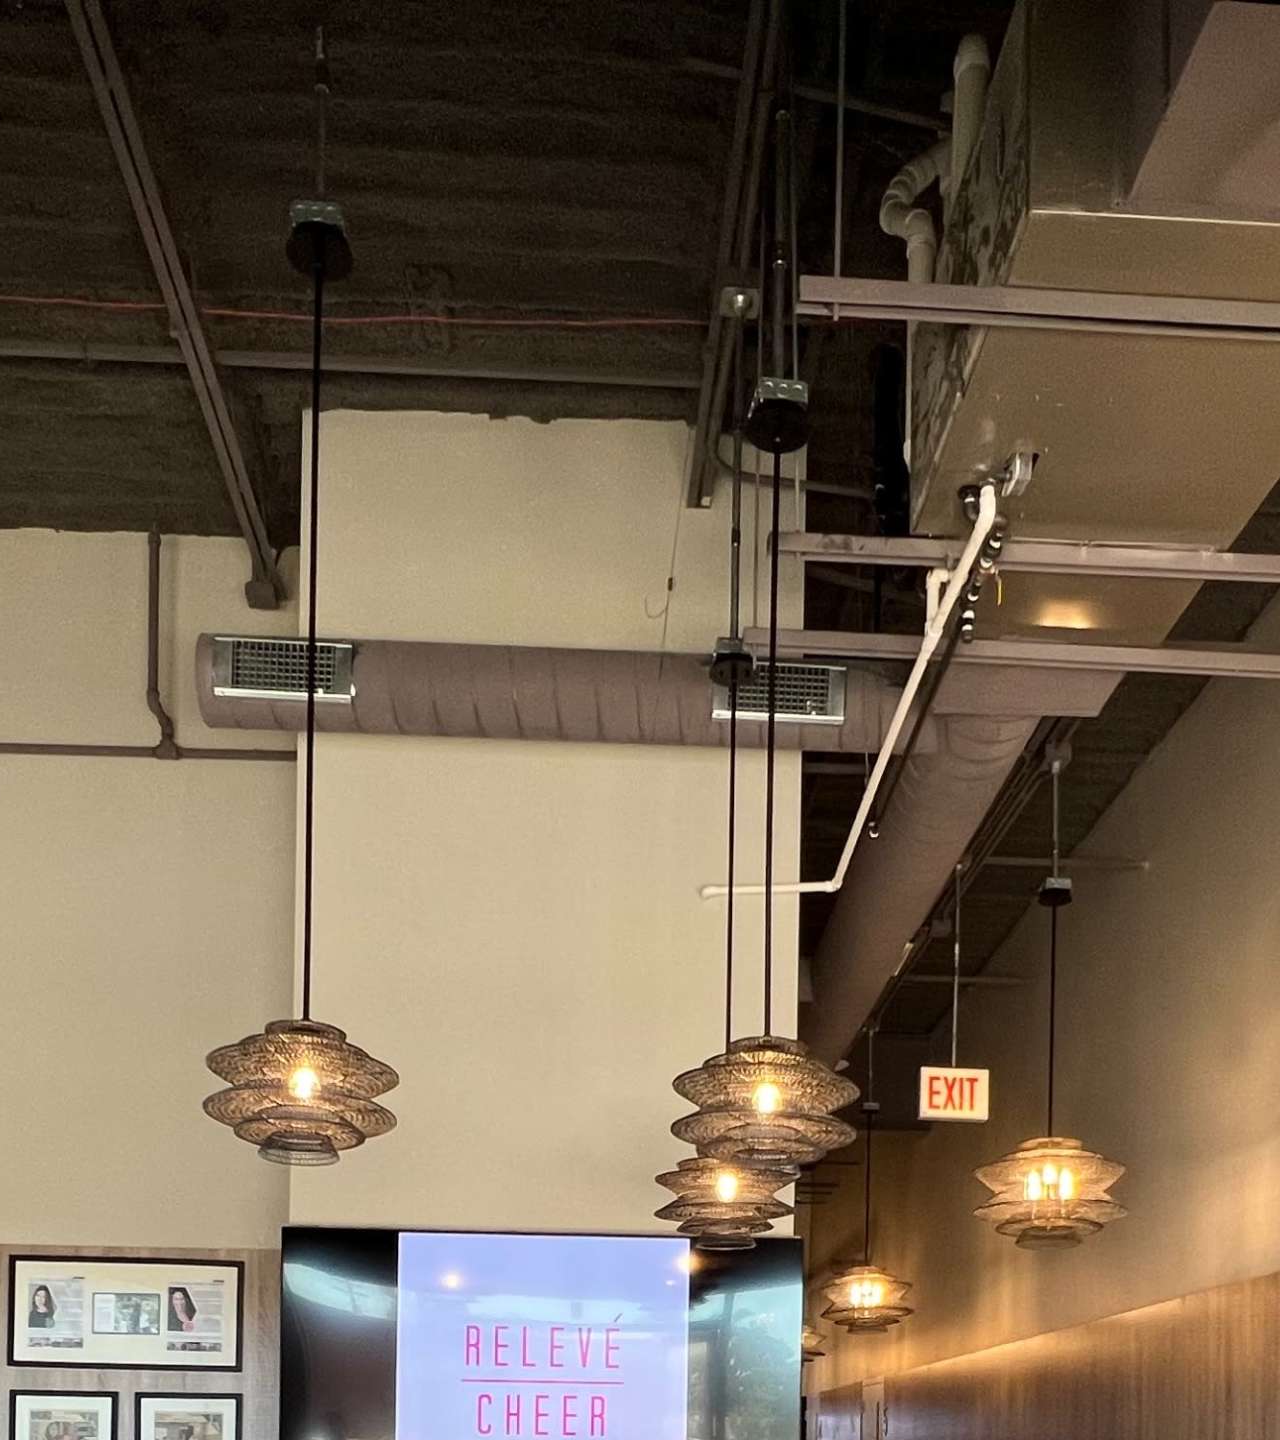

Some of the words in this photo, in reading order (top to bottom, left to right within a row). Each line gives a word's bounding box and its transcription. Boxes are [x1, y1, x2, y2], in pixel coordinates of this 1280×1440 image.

[928, 1076, 979, 1112] EXIT
[465, 1313, 623, 1369] RELEVÉ
[478, 1393, 607, 1437] CHEER
